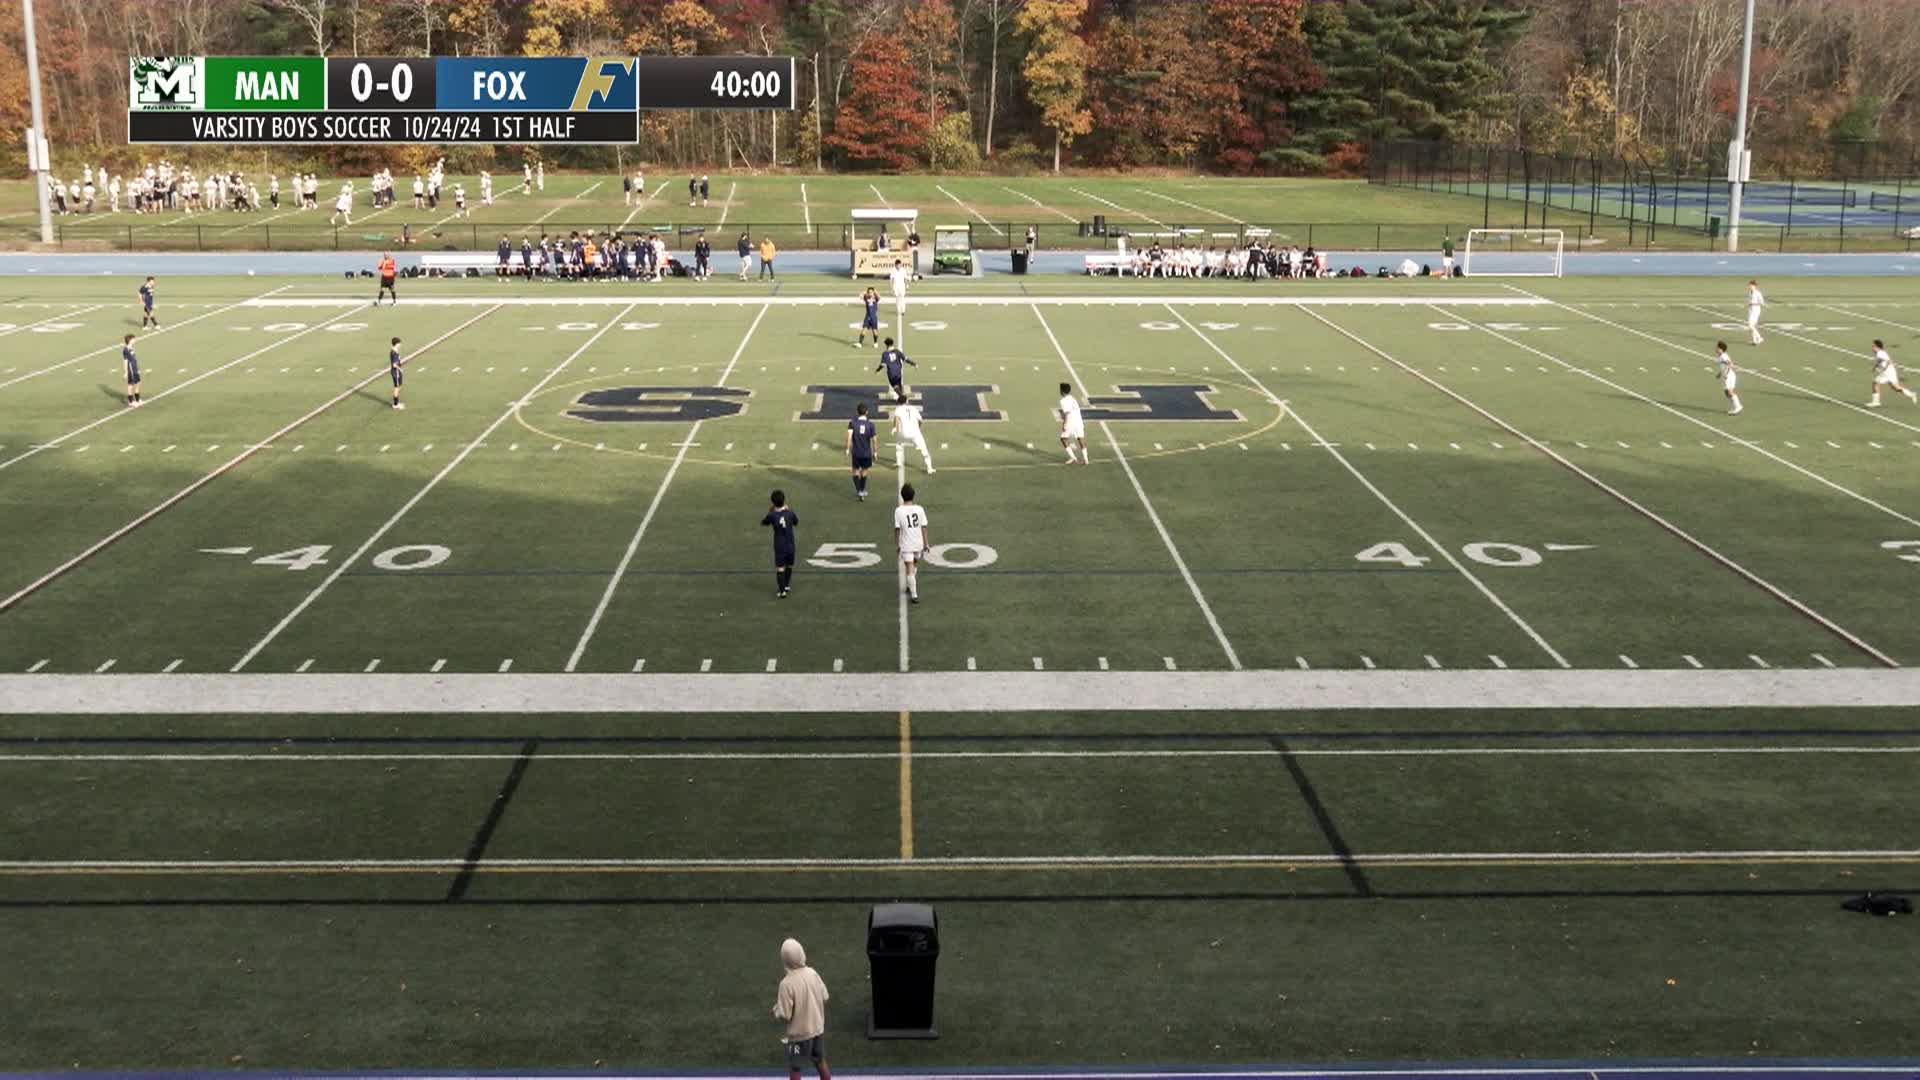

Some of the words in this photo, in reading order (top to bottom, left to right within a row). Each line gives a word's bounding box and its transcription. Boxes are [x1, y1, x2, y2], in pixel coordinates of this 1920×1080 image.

[779, 516, 786, 528] 4
[906, 512, 919, 528] 12
[252, 544, 452, 571] 40
[805, 543, 998, 569] 50
[1354, 542, 1543, 567] 40
